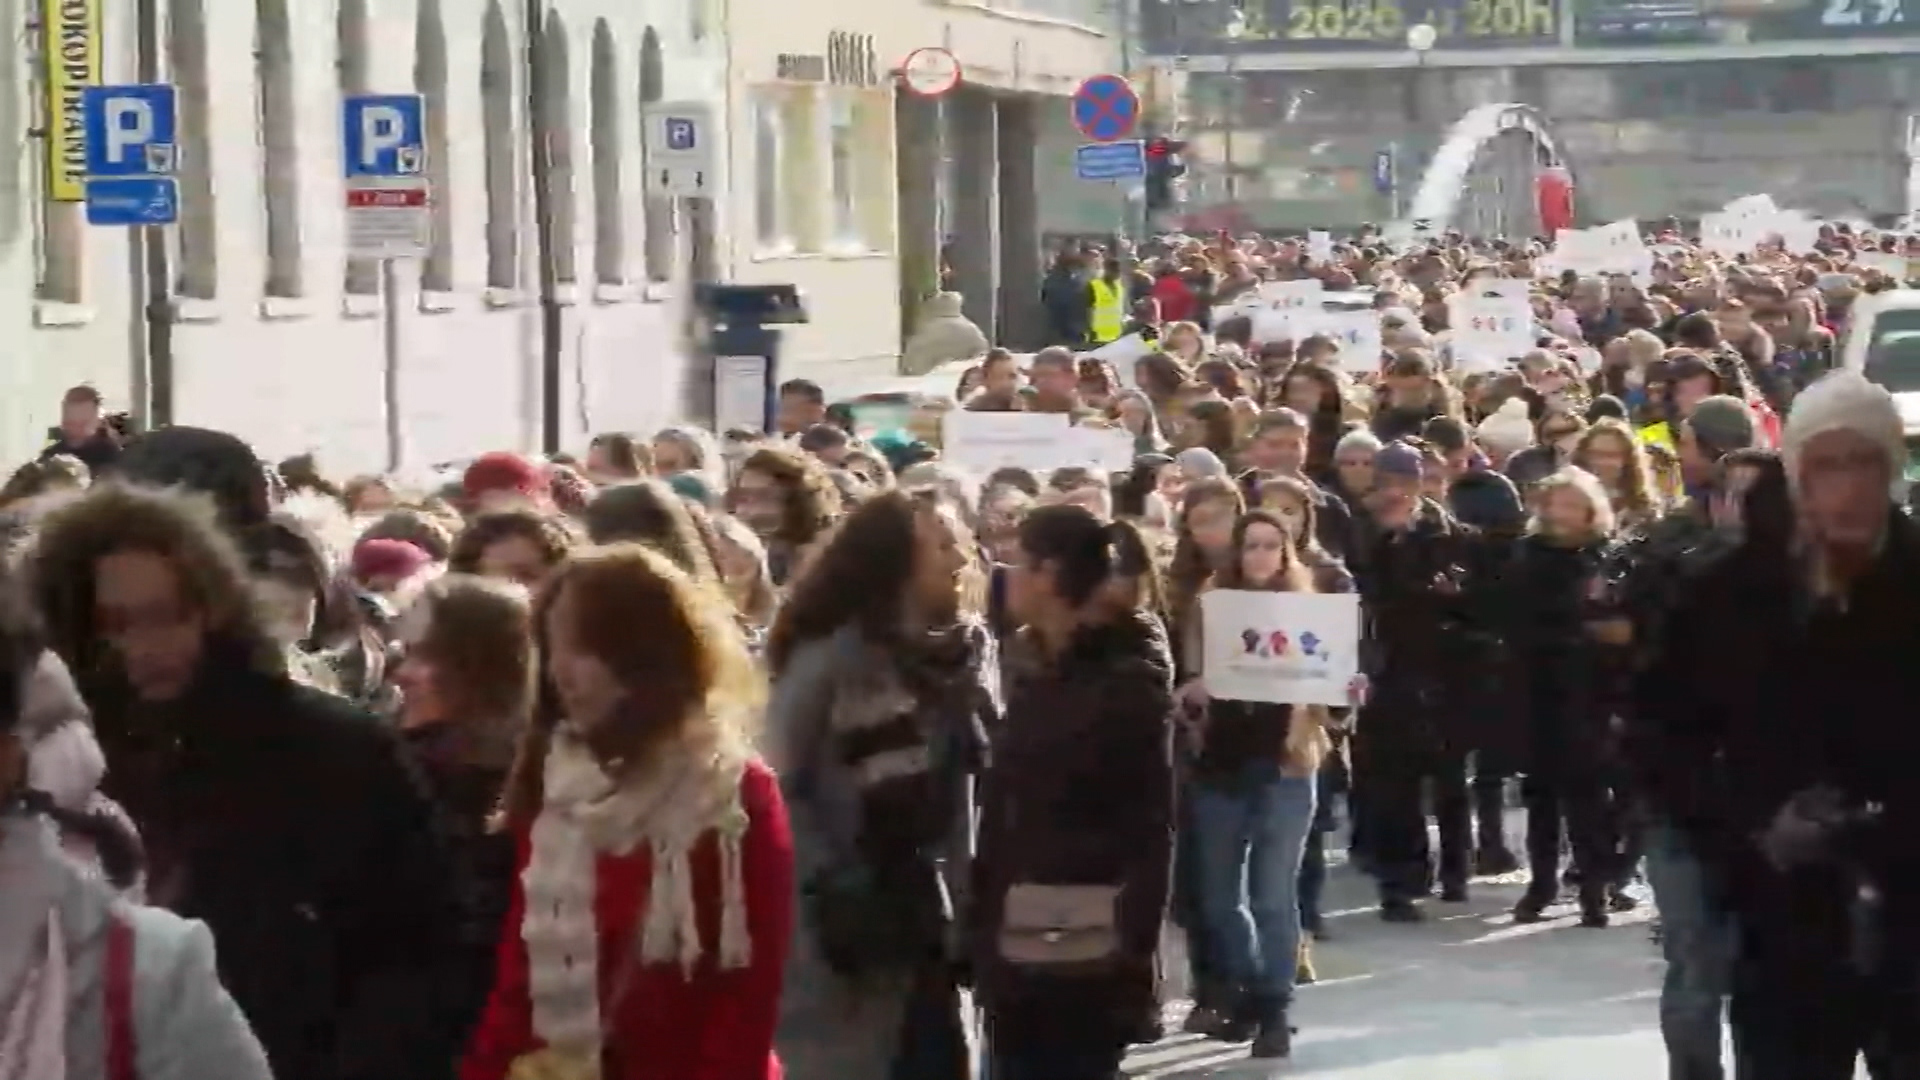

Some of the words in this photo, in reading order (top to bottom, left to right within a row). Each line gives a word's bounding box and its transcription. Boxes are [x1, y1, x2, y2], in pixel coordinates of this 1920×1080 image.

[105, 97, 154, 163] P
[361, 106, 403, 166] P
[672, 122, 690, 142] P
